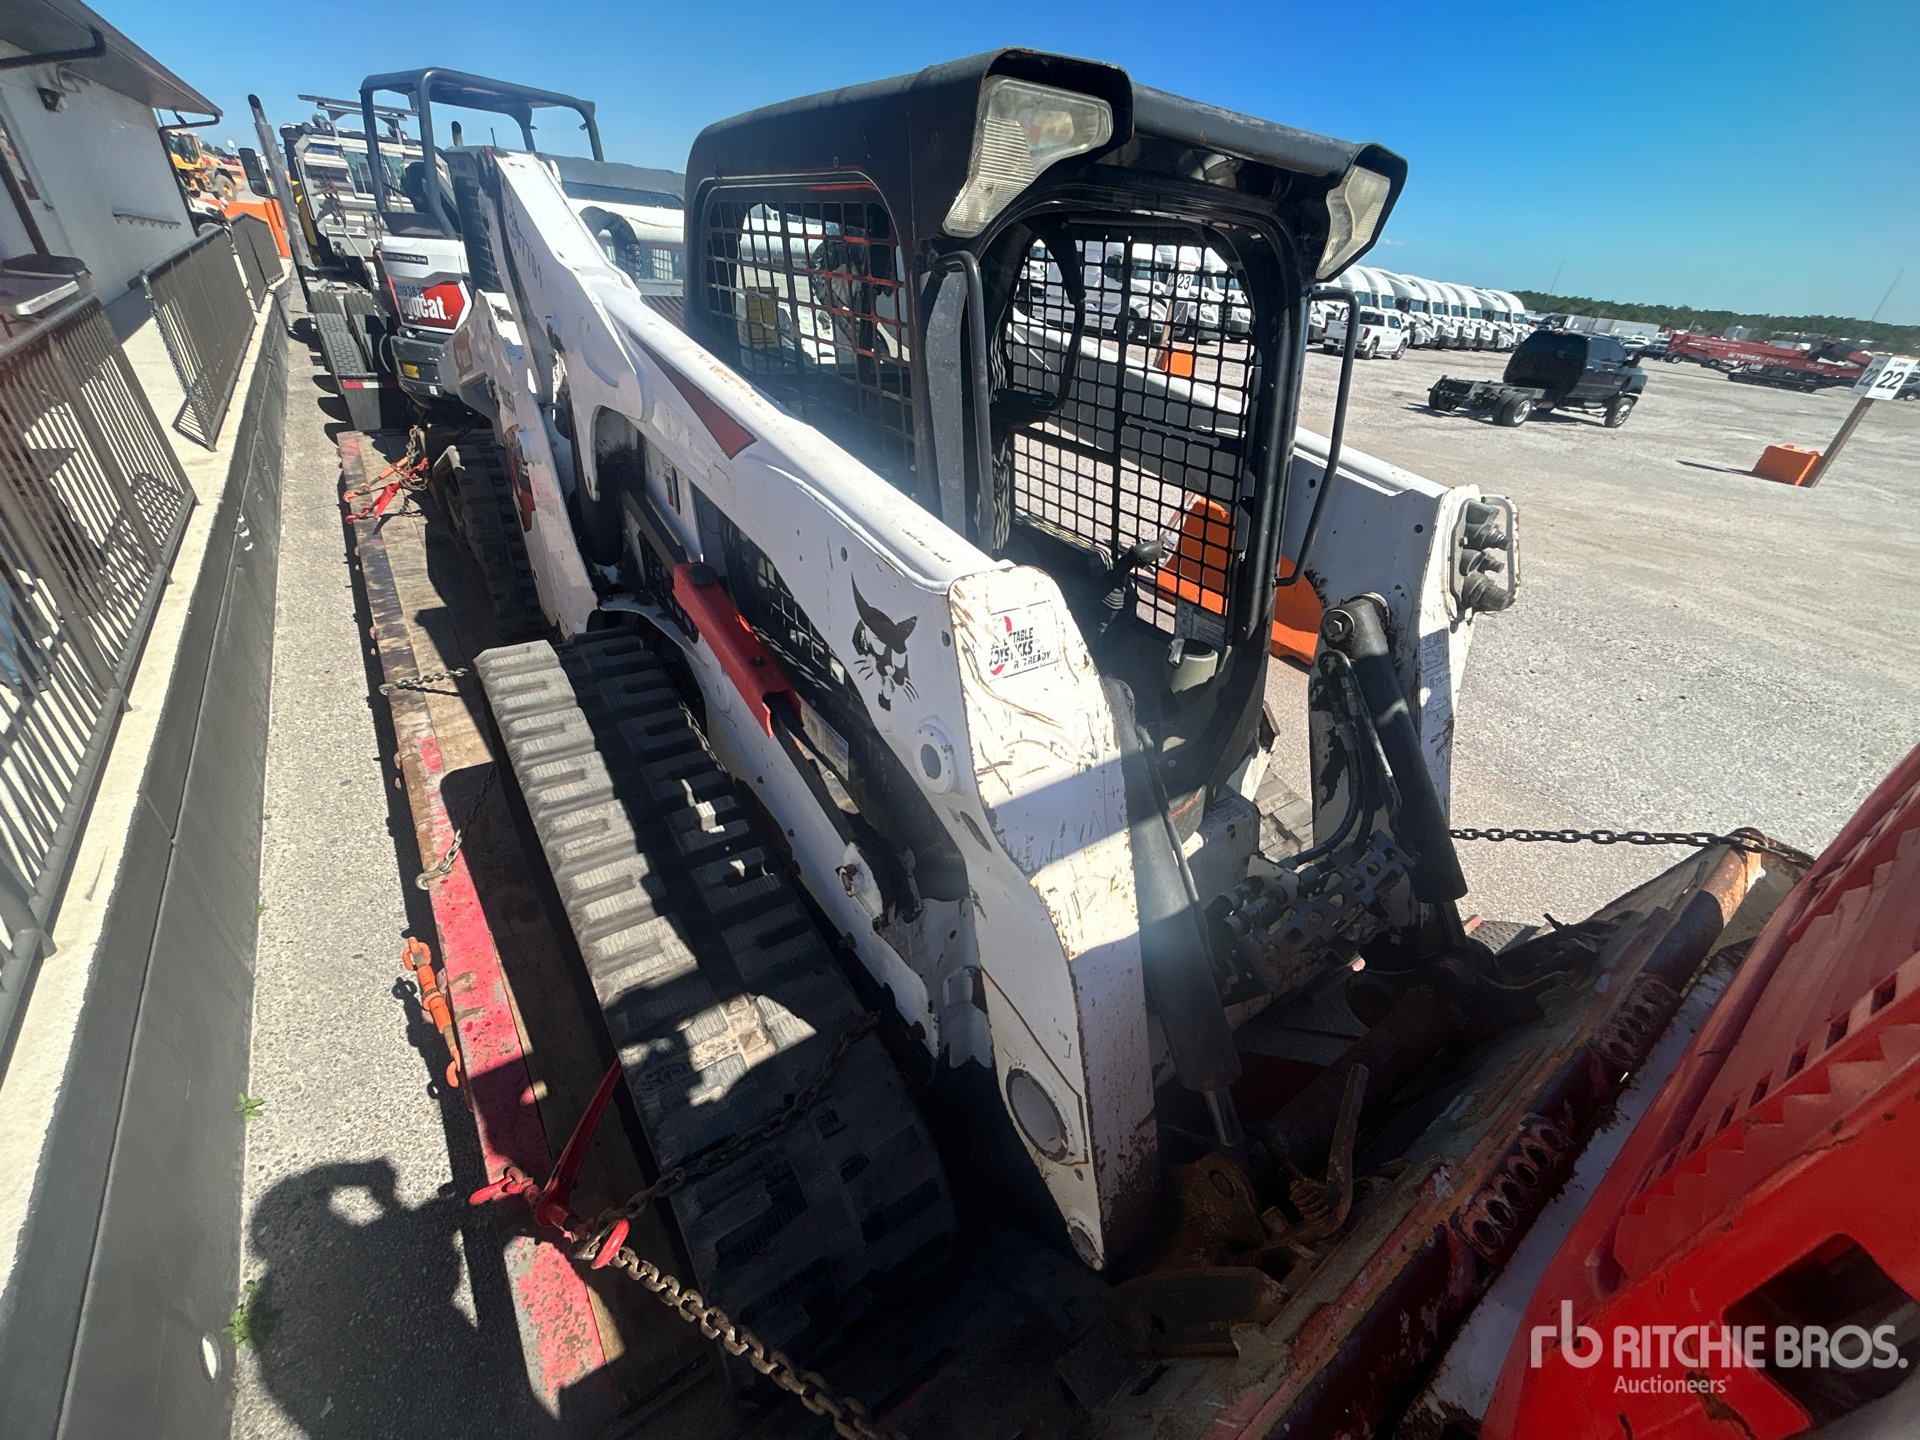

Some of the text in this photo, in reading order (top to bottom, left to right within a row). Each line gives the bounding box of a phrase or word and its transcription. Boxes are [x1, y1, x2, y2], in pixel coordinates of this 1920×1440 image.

[1177, 274, 1191, 290] 23
[1736, 353, 1791, 365] TEREX FINLAY
[1894, 360, 1909, 368] Lane
[1858, 367, 1880, 387] 22
[1875, 370, 1905, 390] 22
